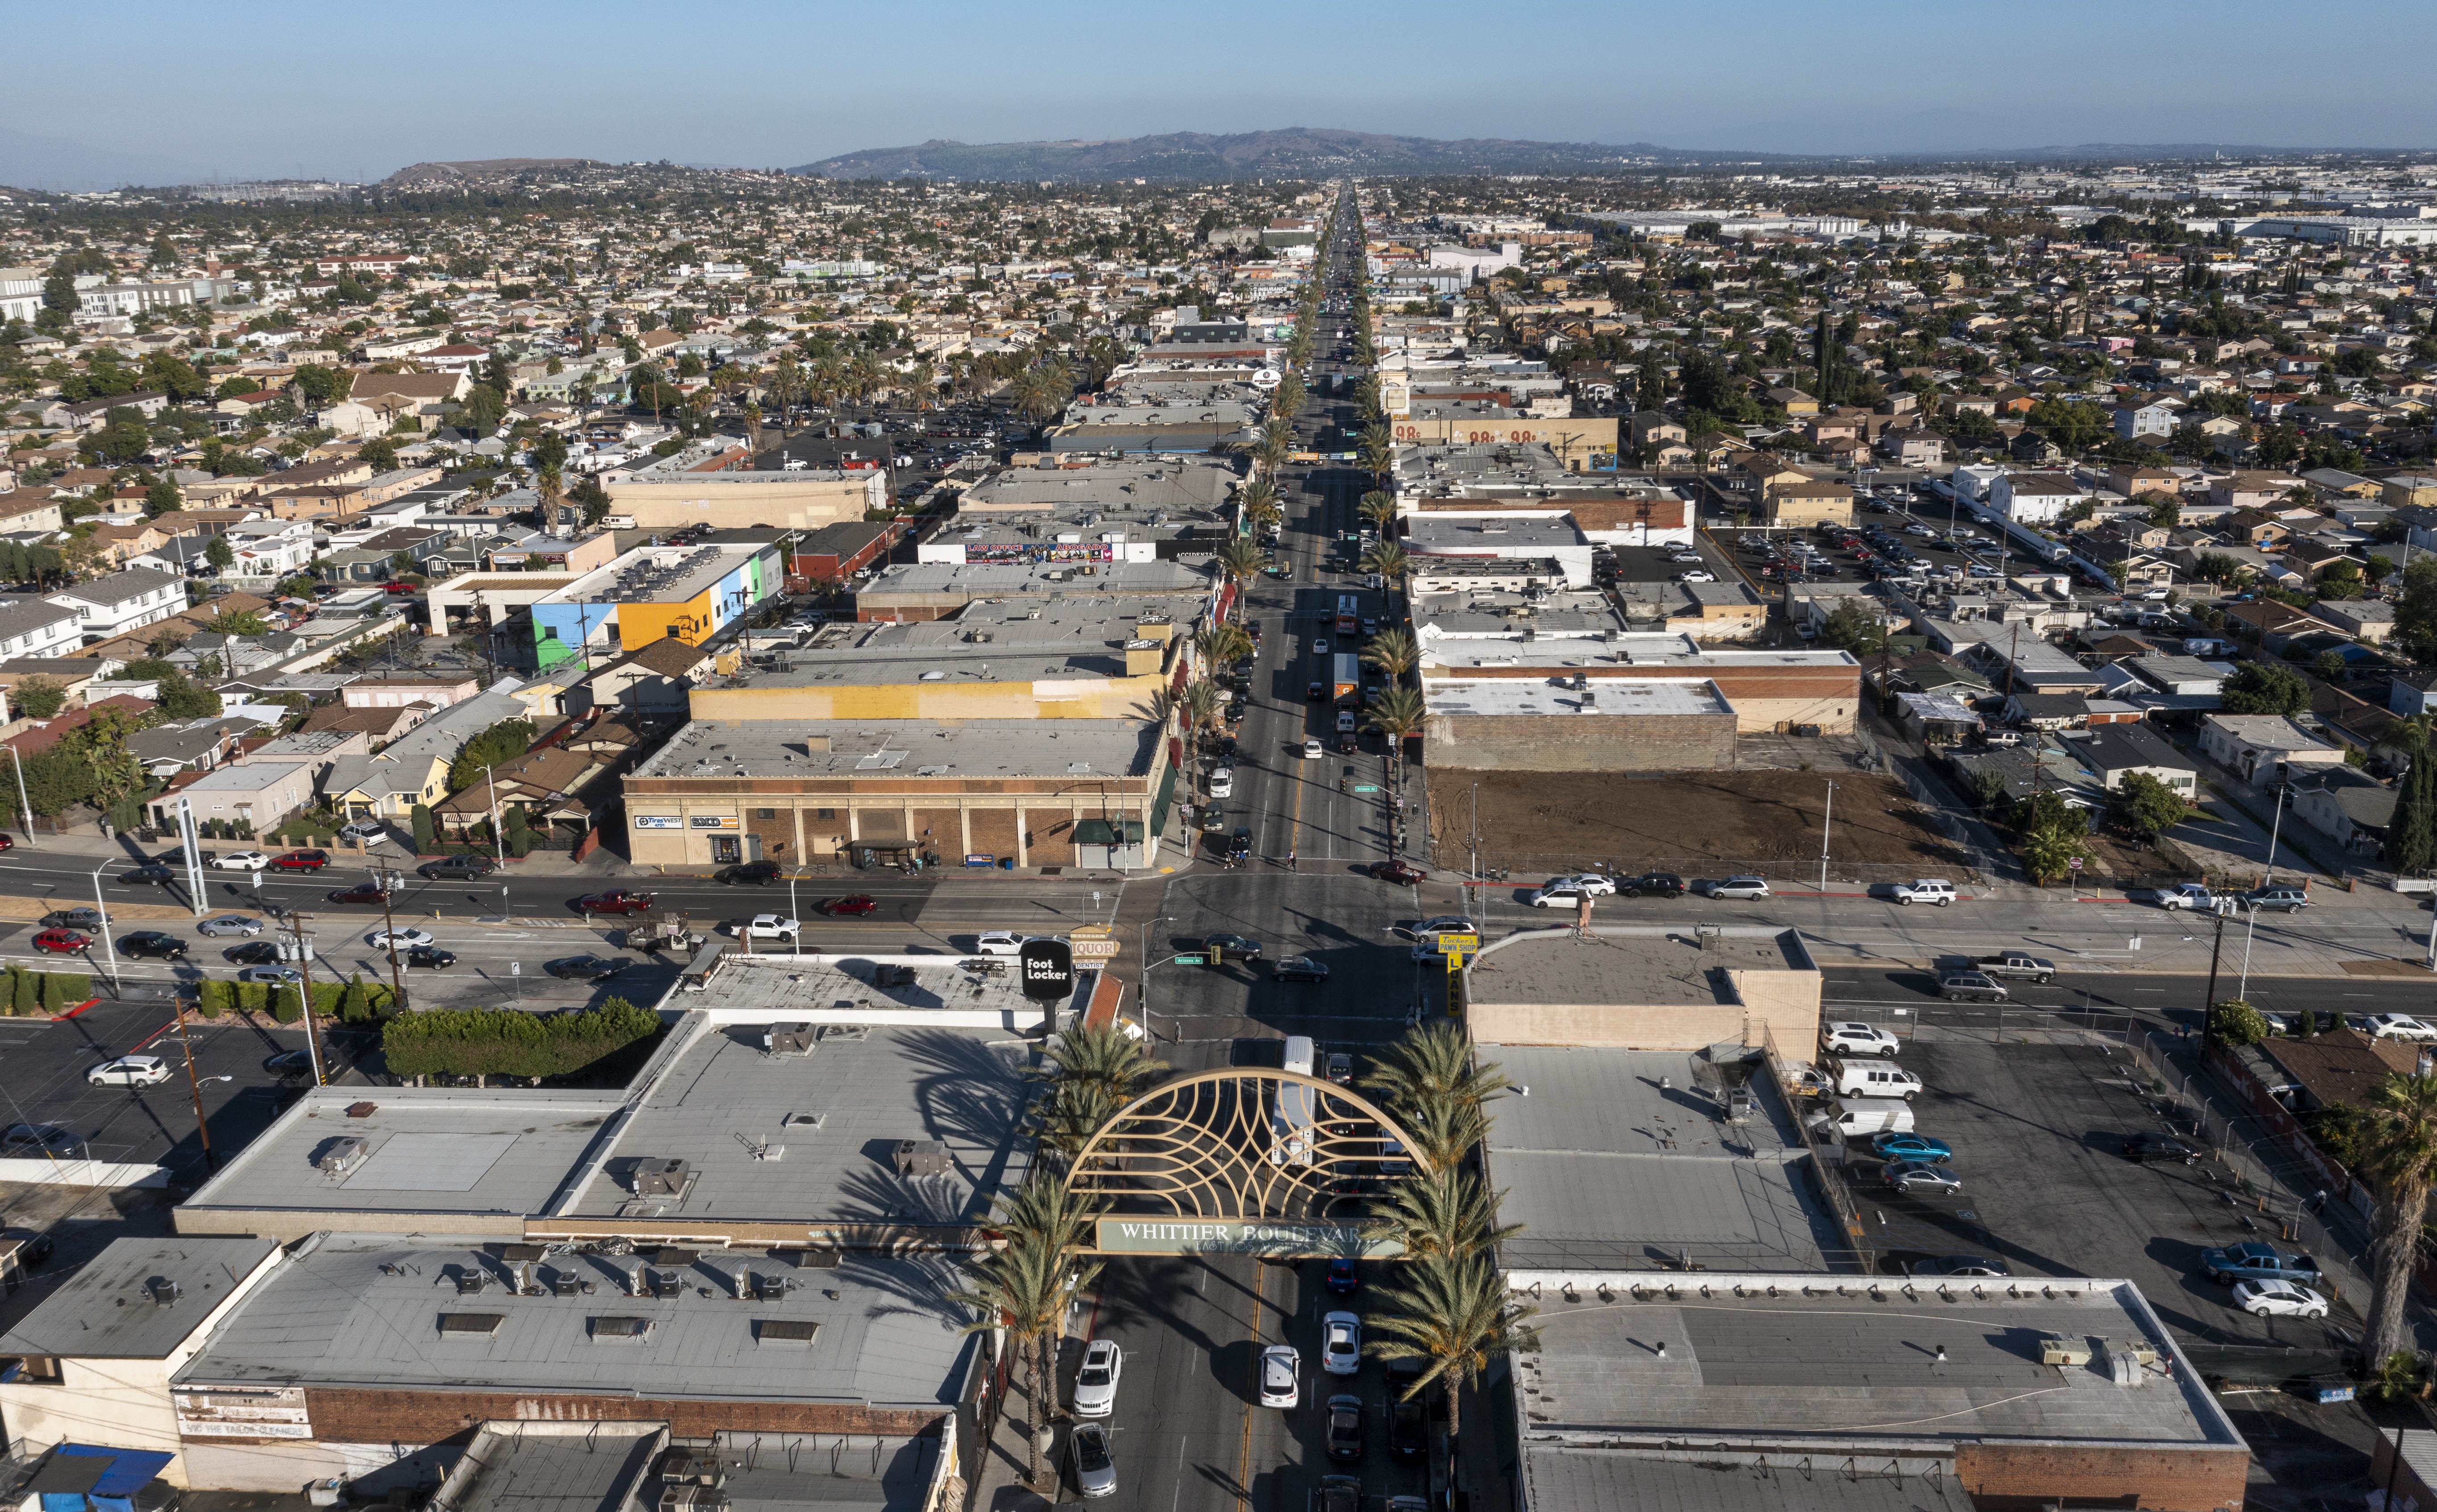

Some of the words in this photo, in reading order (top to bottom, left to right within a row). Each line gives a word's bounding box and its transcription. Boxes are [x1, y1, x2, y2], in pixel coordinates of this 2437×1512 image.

[691, 817, 721, 826] SMD
[1443, 936, 1474, 944] Tucker's
[1072, 943, 1113, 955] IQUOR
[1028, 958, 1053, 969] Foot
[1028, 969, 1067, 980] Locker
[1450, 958, 1459, 1011] LOANS
[1120, 1223, 1230, 1240] WHITTIER
[1243, 1225, 1380, 1243] BOULEVAR
[1196, 1240, 1225, 1251] EAST
[1230, 1241, 1254, 1251] LOS
[1260, 1242, 1311, 1252] ANGELES
[206, 1425, 222, 1433] THE
[260, 1426, 304, 1436] CLEANERS
